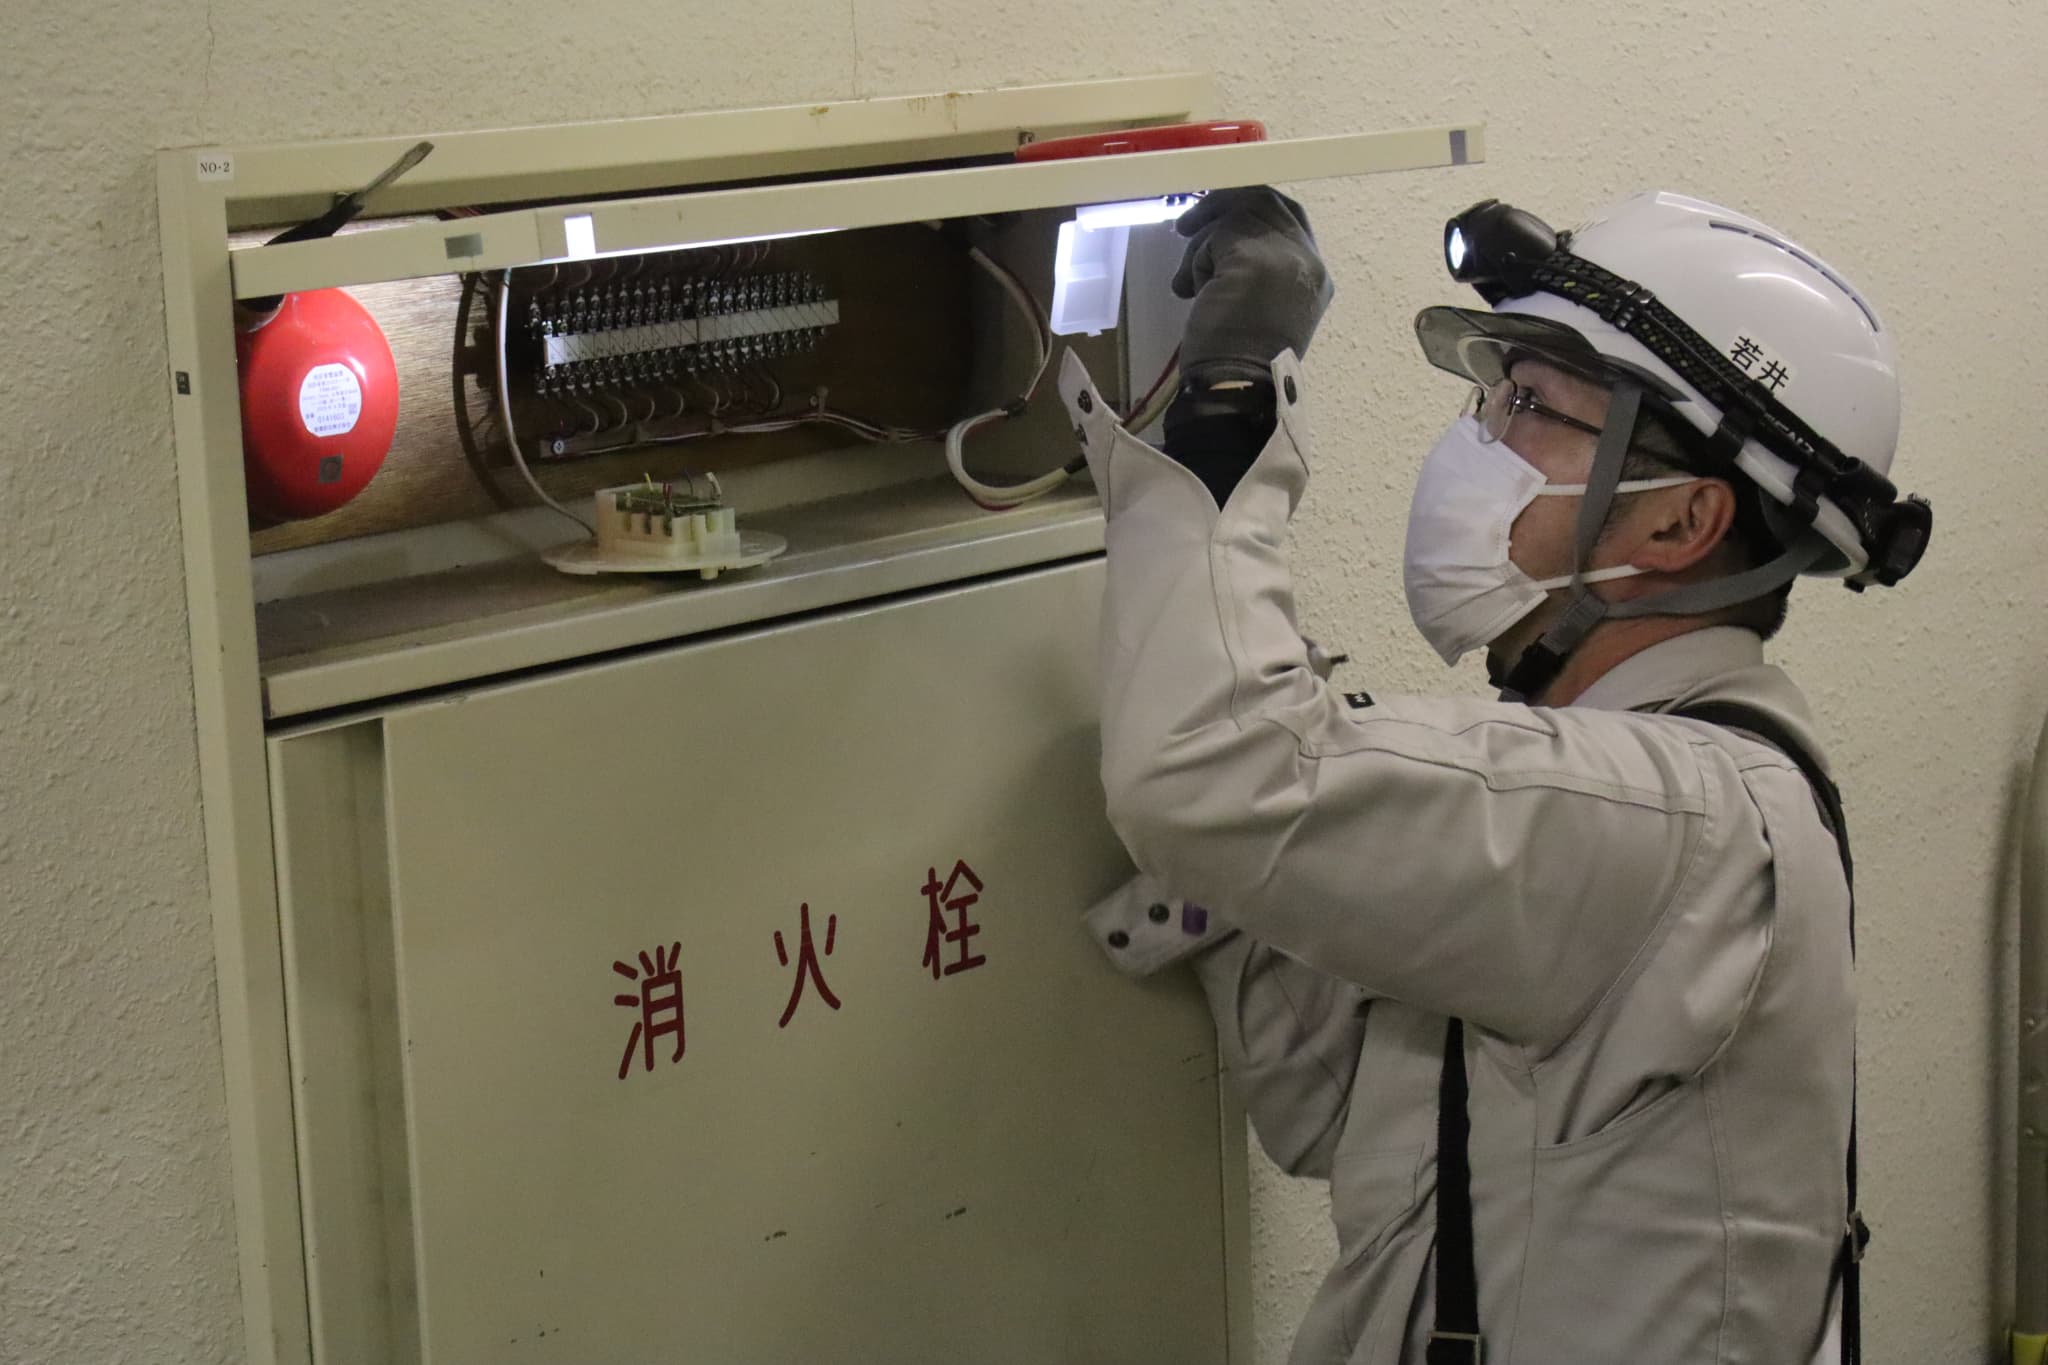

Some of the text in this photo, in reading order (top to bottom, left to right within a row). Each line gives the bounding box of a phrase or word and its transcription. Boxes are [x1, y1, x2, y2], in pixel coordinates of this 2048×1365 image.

[1730, 335, 1789, 391] 若井
[612, 858, 987, 1081] 消火栓
